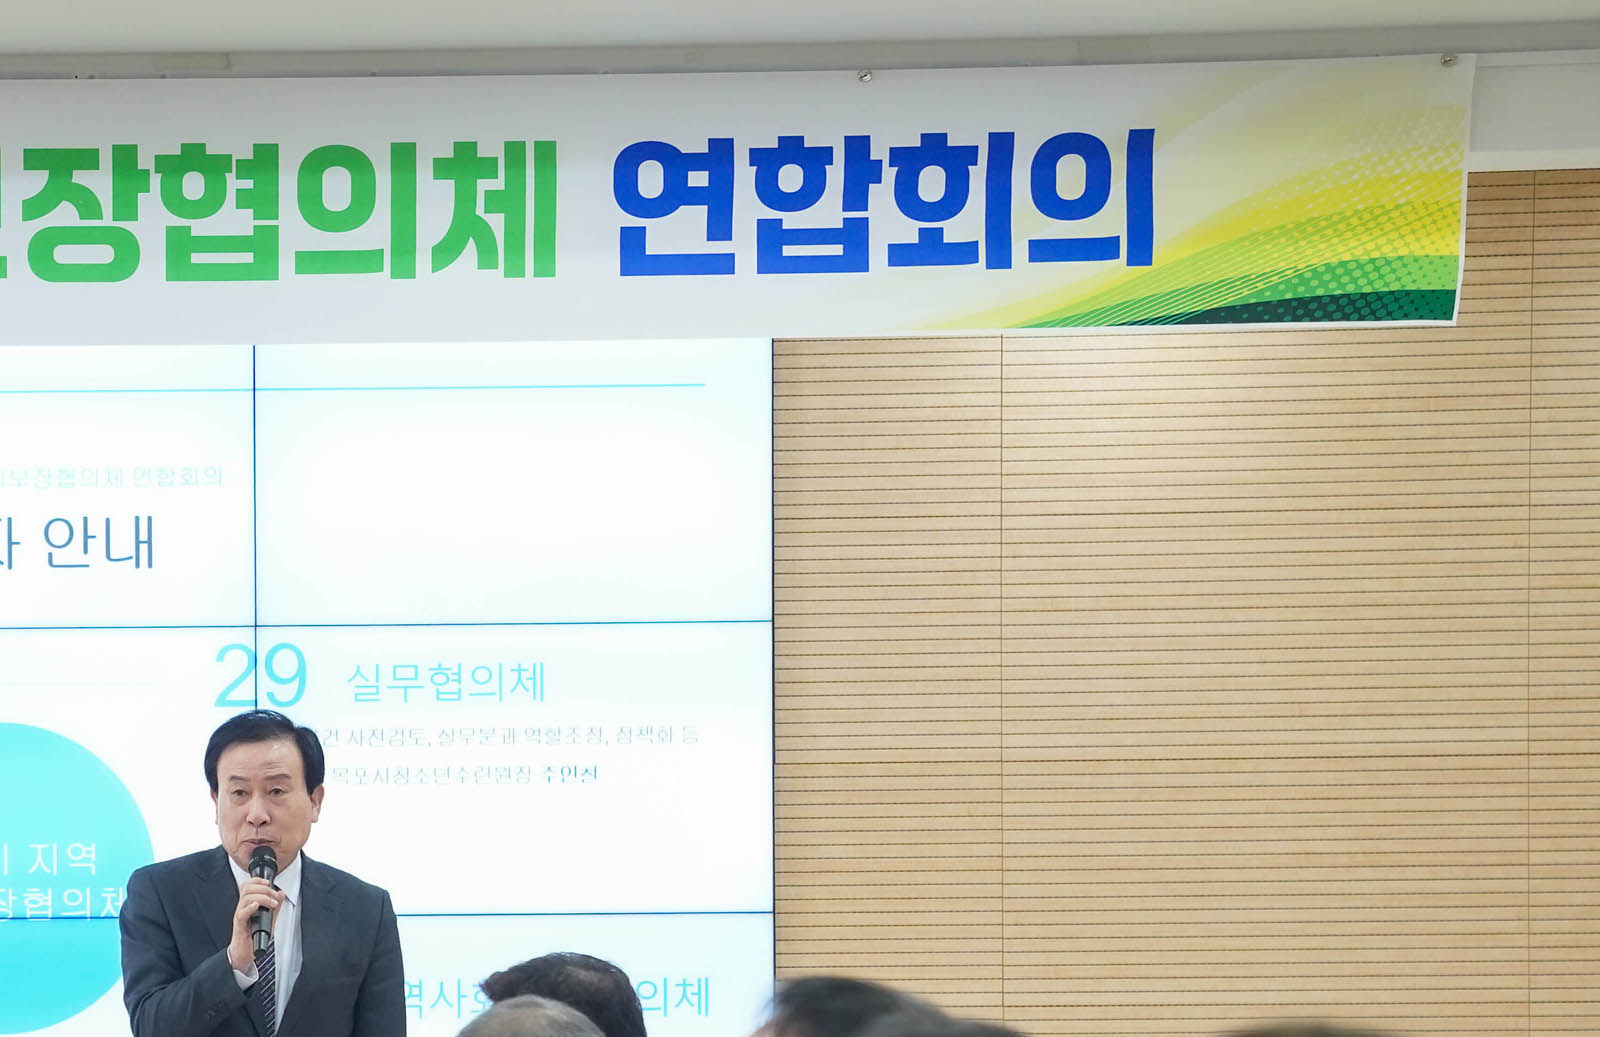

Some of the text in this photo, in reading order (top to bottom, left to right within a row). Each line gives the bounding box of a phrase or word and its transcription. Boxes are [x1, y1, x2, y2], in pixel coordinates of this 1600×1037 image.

[611, 128, 1156, 276] 연합회의
[43, 515, 155, 570] 안내
[214, 642, 307, 707] 29
[346, 661, 546, 703] 실무협의체
[28, 842, 97, 876] 지역
